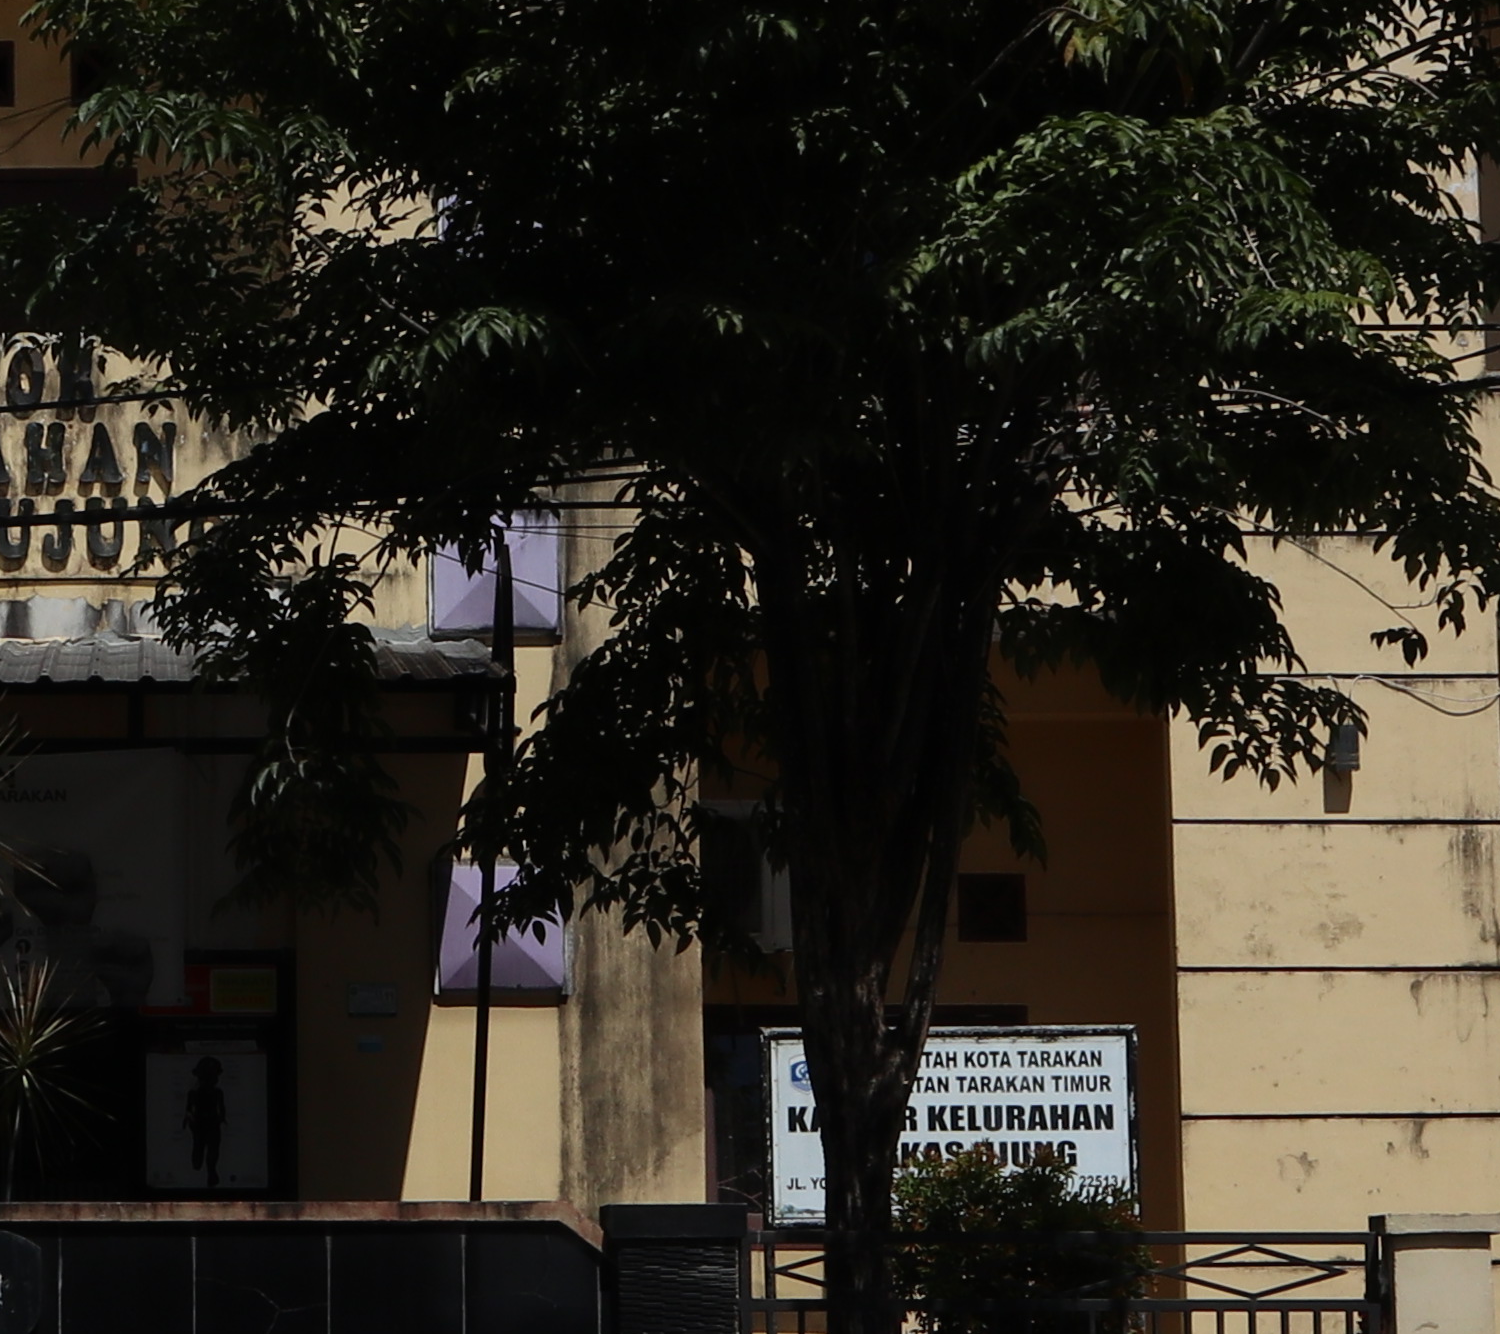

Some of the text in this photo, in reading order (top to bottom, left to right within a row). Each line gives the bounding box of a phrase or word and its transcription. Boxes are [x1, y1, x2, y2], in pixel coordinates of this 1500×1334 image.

[964, 1051, 1011, 1067] KOTA
[1018, 1050, 1102, 1067] TARAKAN
[956, 1076, 1044, 1092] TARAKAN
[1052, 1075, 1112, 1092] TIMUR
[928, 1104, 1114, 1132] KELURAHAN
